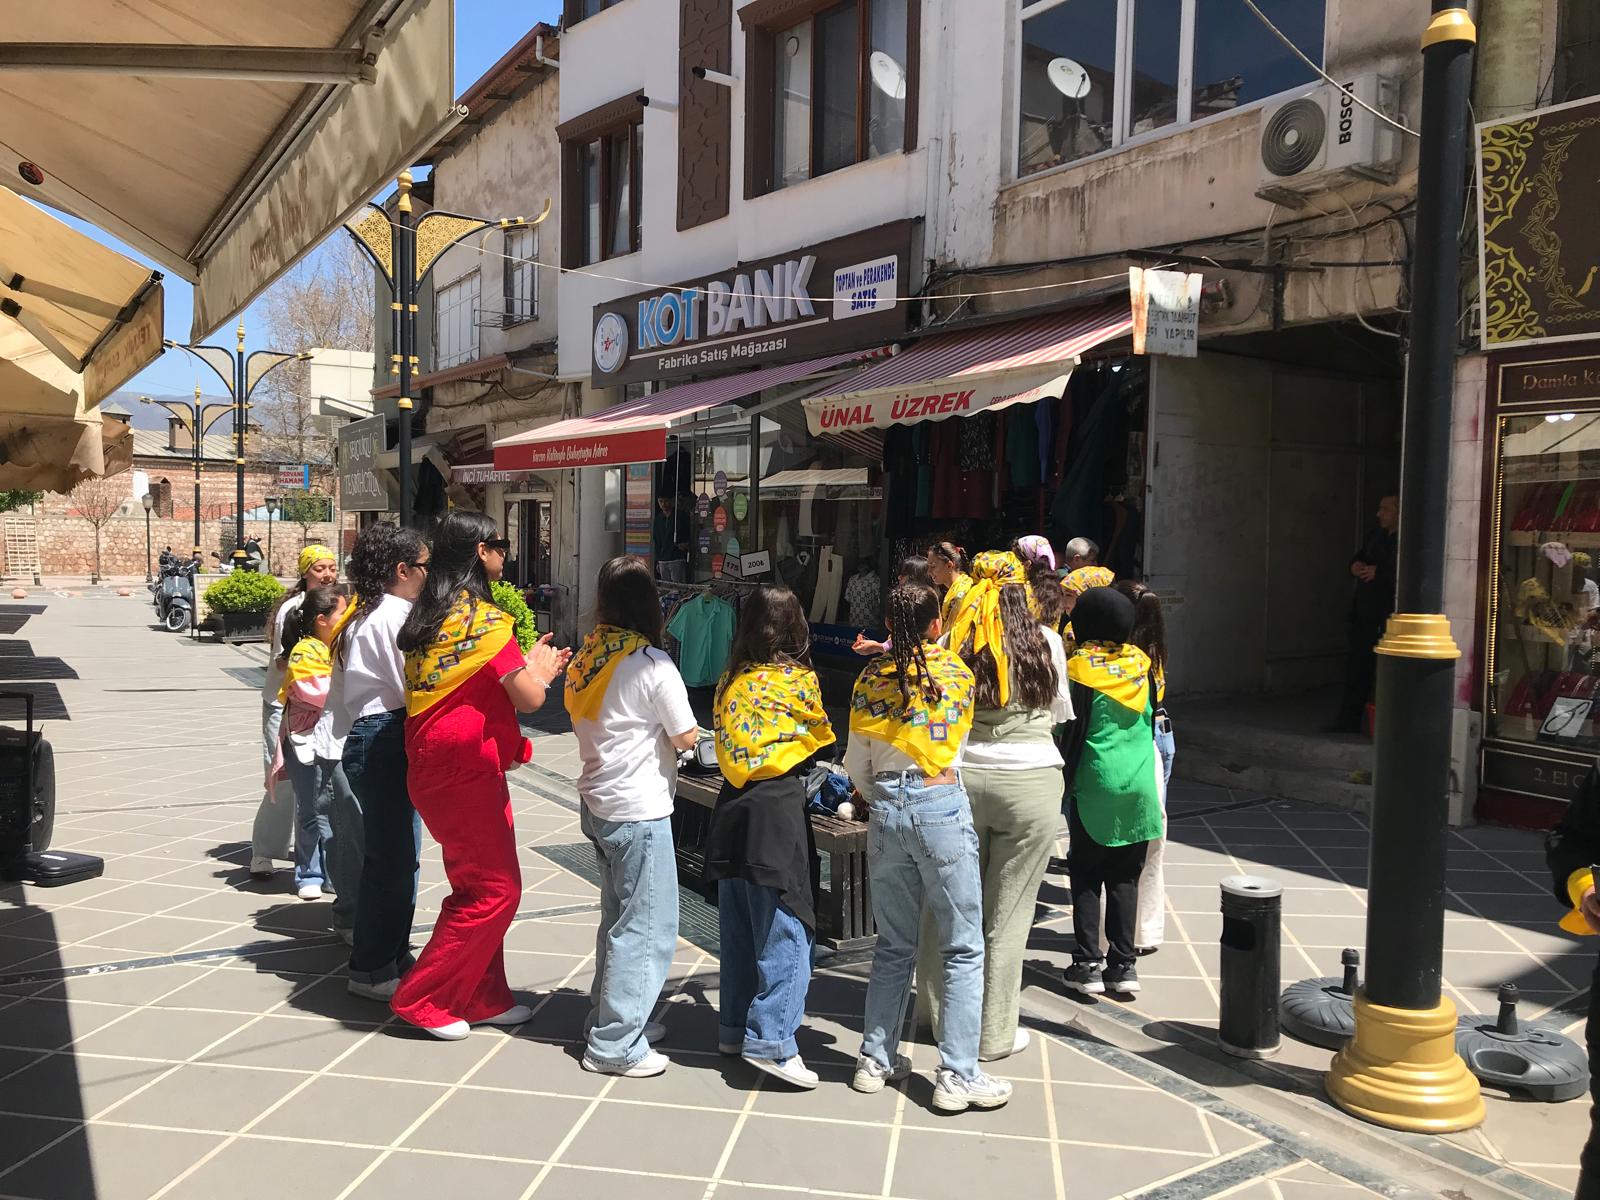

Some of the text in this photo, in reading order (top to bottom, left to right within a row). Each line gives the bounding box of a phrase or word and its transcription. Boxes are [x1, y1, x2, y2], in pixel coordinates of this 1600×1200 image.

[1339, 82, 1354, 144] BOSCH
[836, 262, 895, 292] TOPTAN ve PERAKENDE
[638, 287, 704, 350] KOT
[707, 255, 817, 337] BANK
[851, 288, 877, 311] SATIŞ
[658, 338, 787, 370] Fabrika Satış Mağazası
[1523, 374, 1577, 390] Damla
[820, 403, 875, 428] ÜNAL
[890, 389, 976, 419] ÜZREK
[463, 469, 475, 483] İNCİ
[1552, 770, 1568, 786] El
